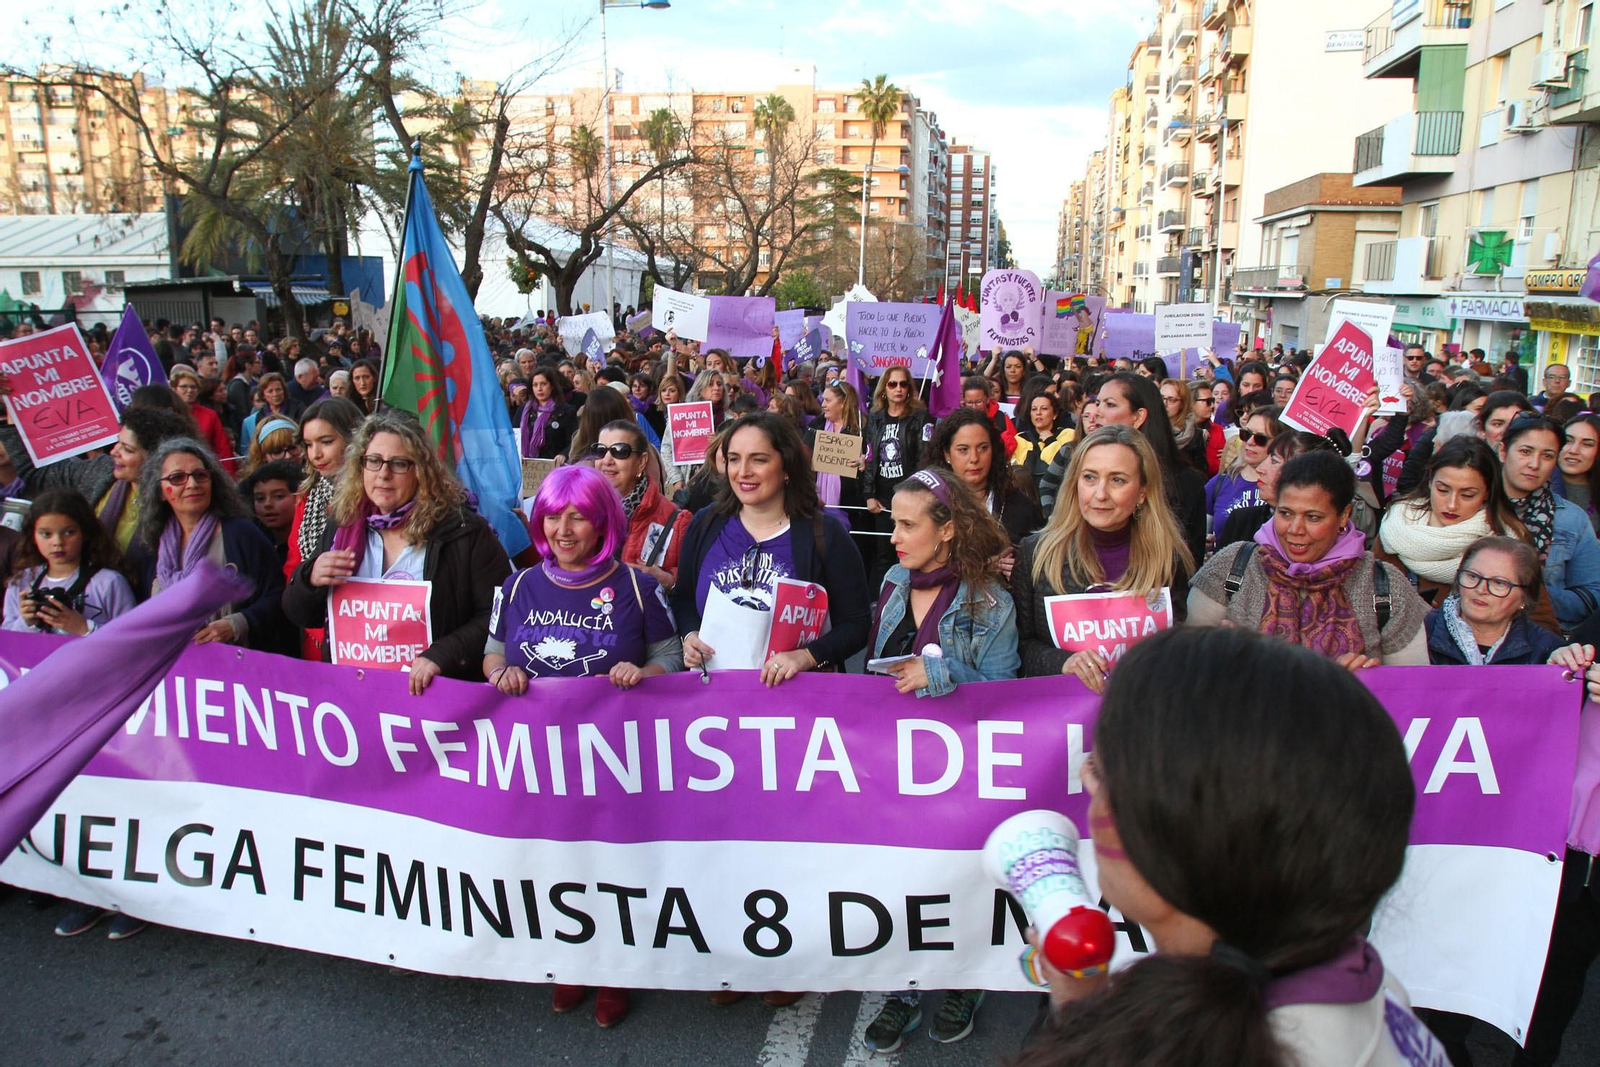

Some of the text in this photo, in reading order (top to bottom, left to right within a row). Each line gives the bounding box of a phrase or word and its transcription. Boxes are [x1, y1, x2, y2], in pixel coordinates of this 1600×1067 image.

[1326, 40, 1363, 48] DENTISTA
[982, 274, 1007, 306] JUNTAS
[1014, 275, 1036, 303] FUERTES
[1526, 273, 1563, 289] COMPRO
[857, 311, 875, 320] TODO
[886, 313, 899, 322] QUE
[904, 313, 927, 323] PUEDES
[1461, 299, 1521, 318] FARMACIA
[859, 326, 878, 337] HACER
[904, 328, 925, 338] PUEDO
[987, 328, 1029, 346] FEMINISTAS
[874, 342, 896, 352] HACER
[1333, 337, 1374, 373] APUNT
[0, 345, 78, 376] APUNTA
[869, 355, 913, 368] SANGRANDO
[33, 367, 60, 386] MI
[1339, 361, 1361, 381] MI
[12, 375, 98, 411] NOMBRE
[1310, 363, 1368, 408] NOMBRE
[1305, 387, 1346, 419] EVA
[33, 399, 102, 430] EVA
[673, 410, 708, 421] APUNTA
[673, 428, 711, 439] NOMBRE
[819, 433, 854, 448] ESPACIO
[817, 454, 852, 467] AUSENTE
[339, 599, 417, 622] APUNTA
[524, 609, 613, 631] ANDALUCÍA
[779, 604, 827, 627] APUNT
[365, 623, 388, 642] MI
[1063, 616, 1158, 642] APUNTA
[339, 641, 424, 663] NOMBRE
[1098, 643, 1127, 662] MI
[379, 711, 861, 797] FEMINISTA
[896, 718, 1027, 801] DE
[19, 813, 267, 896] UELGA
[294, 837, 712, 954] FEMINISTA
[743, 888, 793, 958] 8
[828, 890, 955, 958] DE
